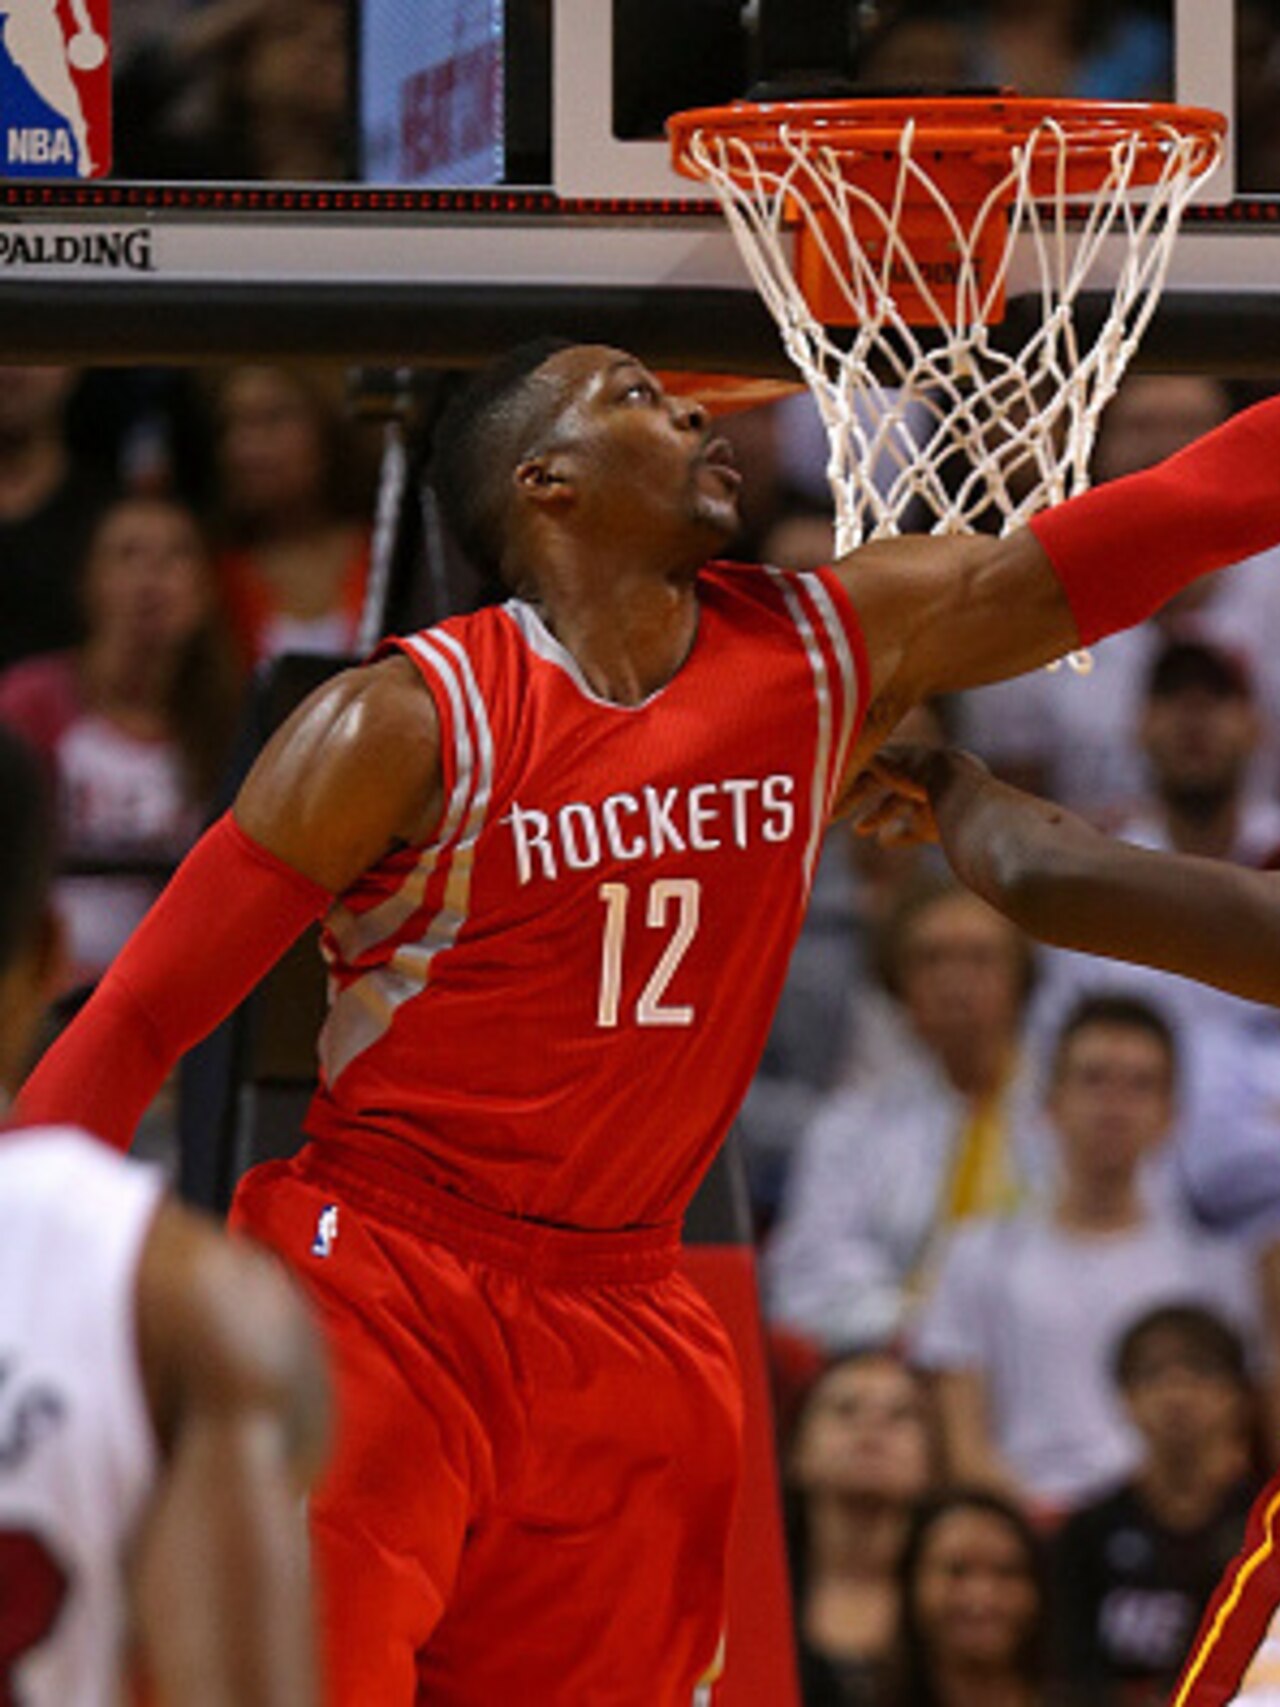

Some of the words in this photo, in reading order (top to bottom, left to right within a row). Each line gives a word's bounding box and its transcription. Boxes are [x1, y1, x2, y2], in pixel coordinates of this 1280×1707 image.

[7, 128, 73, 164] NBA
[0, 228, 157, 272] PALDING
[497, 773, 795, 886] ROCKETS
[597, 878, 701, 1027] 12
